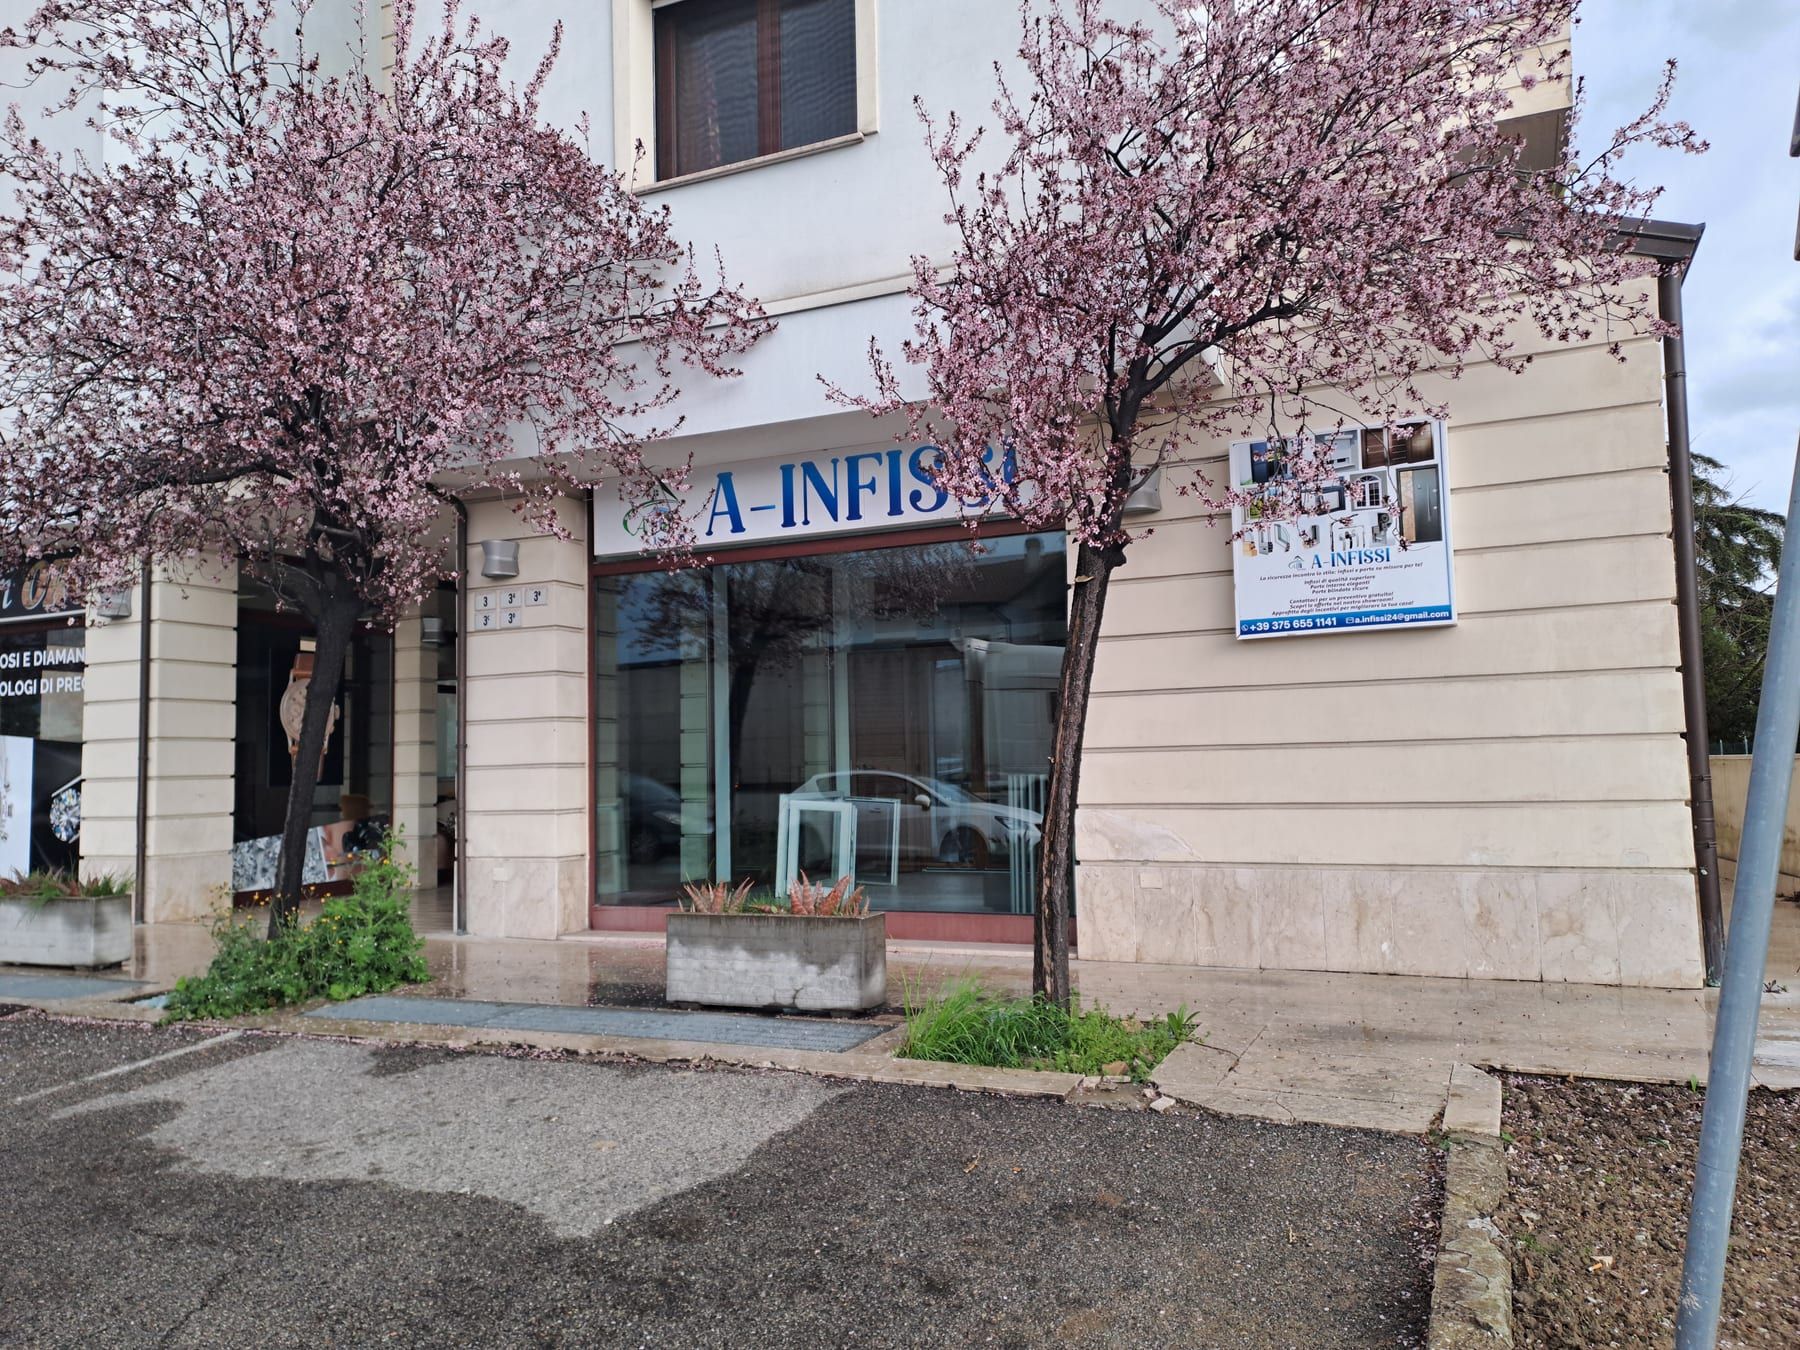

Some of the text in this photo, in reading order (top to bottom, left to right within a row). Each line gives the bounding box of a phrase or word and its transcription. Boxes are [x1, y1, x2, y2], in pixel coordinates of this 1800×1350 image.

[705, 436, 1020, 536] A-INFISI
[1311, 547, 1391, 569] A-INFISSI
[483, 596, 488, 607] 3
[1337, 593, 1367, 601] preventivo
[1250, 611, 1449, 632] +39 375 655 1141 a.infissi24@gmail.com
[22, 651, 31, 667] E
[40, 678, 53, 694] DI
